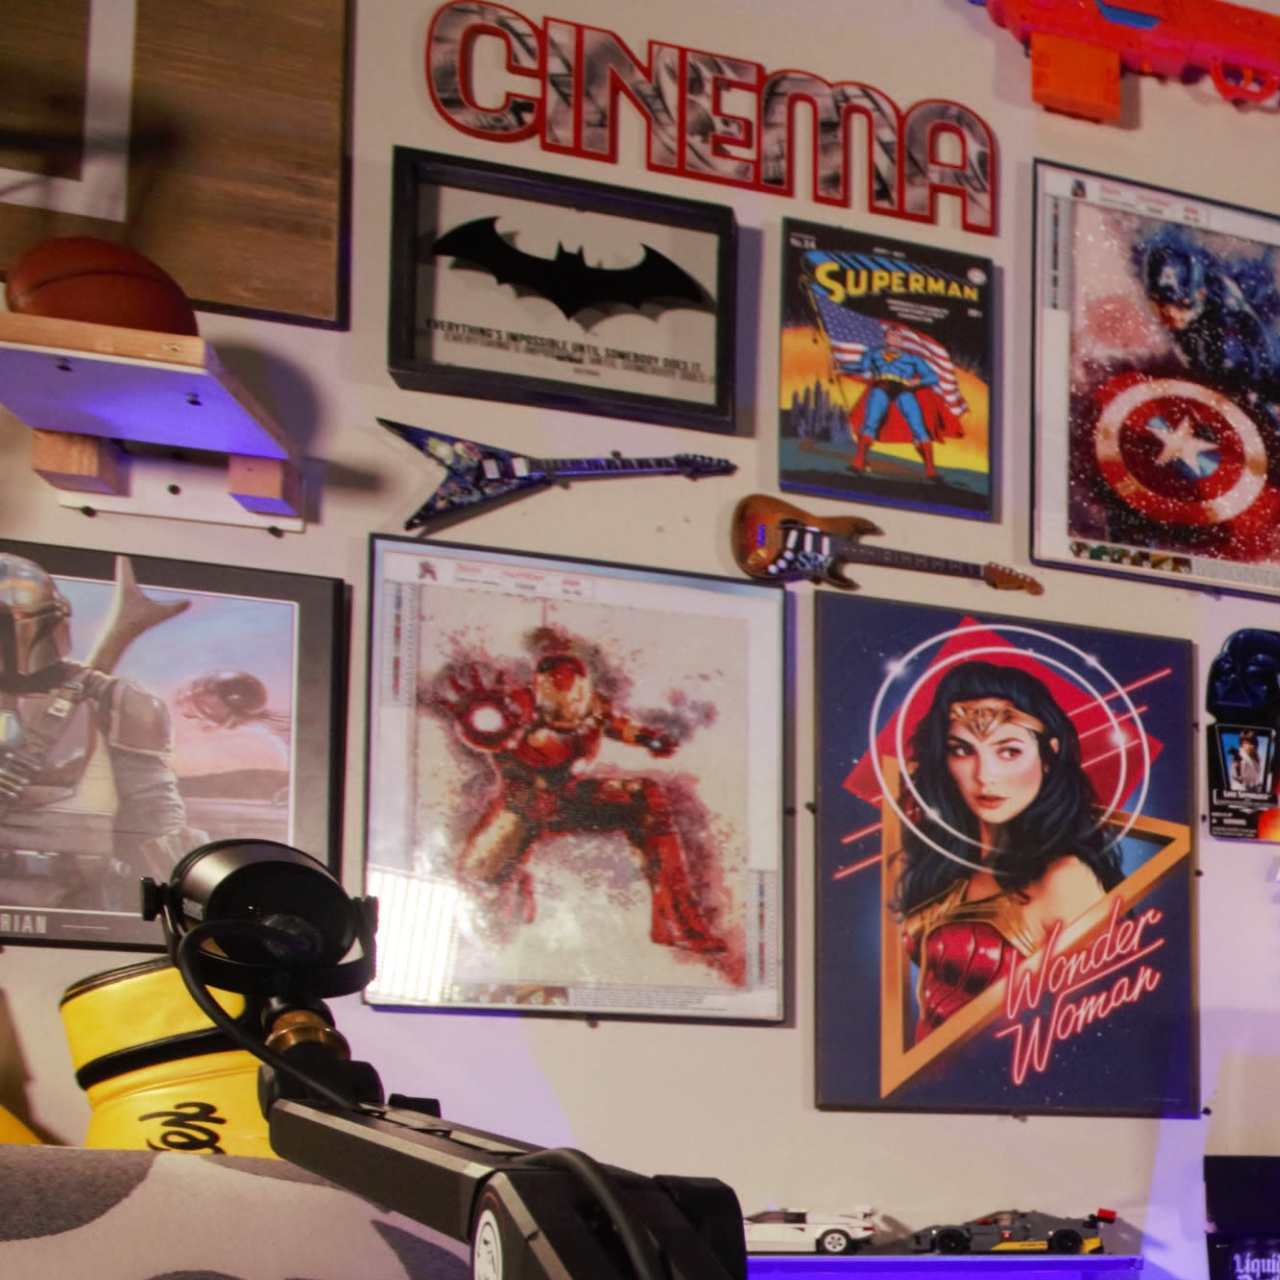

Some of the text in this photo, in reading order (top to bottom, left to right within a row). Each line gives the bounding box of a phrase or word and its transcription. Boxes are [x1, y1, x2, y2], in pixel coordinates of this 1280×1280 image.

[425, 0, 998, 236] CINEMA
[815, 261, 979, 304] SUPERMAN
[1005, 898, 1163, 1020] Wonder
[995, 968, 1162, 1087] Woman
